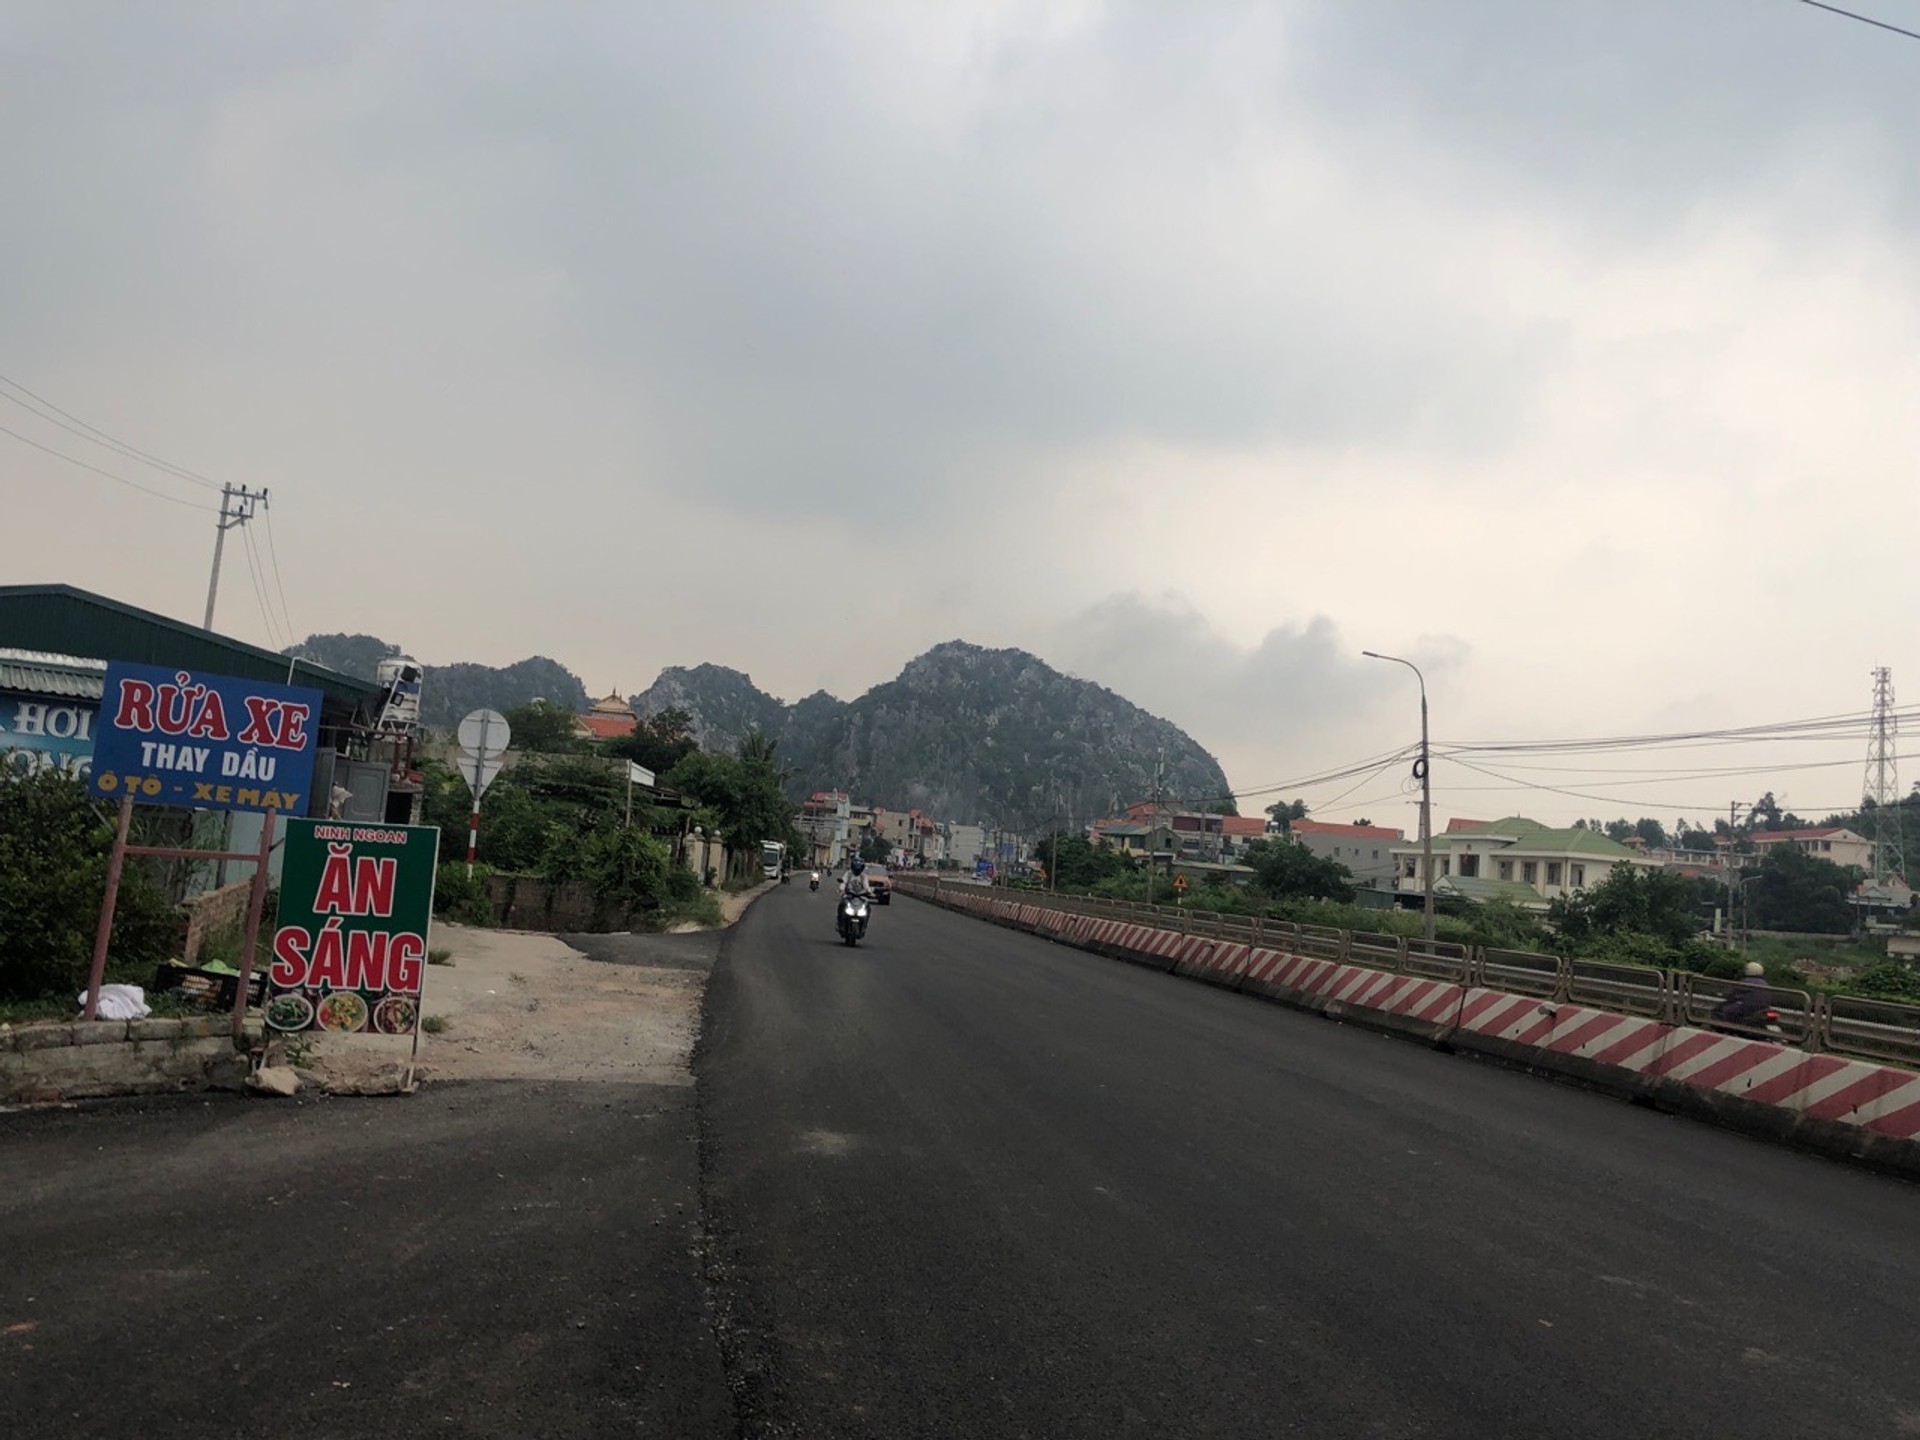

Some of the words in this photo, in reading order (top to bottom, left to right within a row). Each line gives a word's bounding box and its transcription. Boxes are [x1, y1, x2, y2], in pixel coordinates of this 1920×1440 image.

[12, 701, 93, 741] HƠI
[114, 670, 230, 740] RỬA
[238, 696, 310, 751] XE
[141, 741, 210, 773] THAY
[221, 747, 276, 781] DẦU
[97, 770, 118, 792] Ô
[124, 774, 162, 796] TÔ
[192, 782, 232, 804] XE
[236, 787, 300, 810] MÁY
[314, 825, 351, 840] NINH
[353, 828, 407, 844] NGOAN
[312, 842, 397, 917] ĂN
[270, 916, 424, 992] SÁNG
